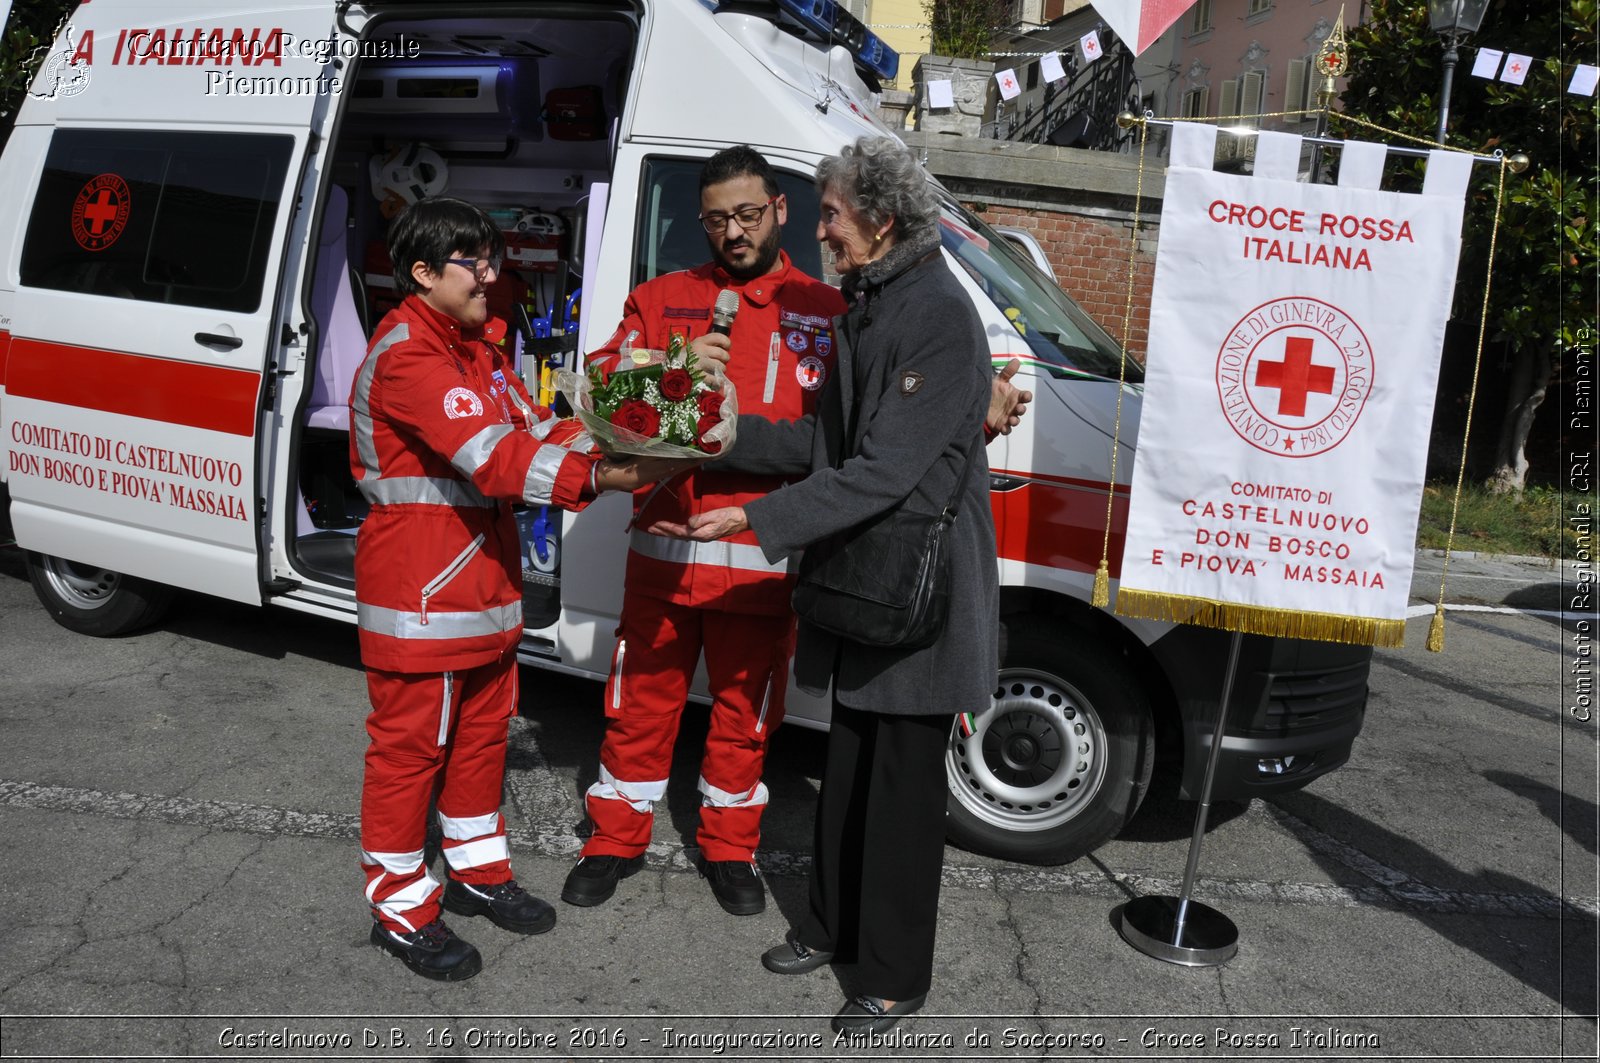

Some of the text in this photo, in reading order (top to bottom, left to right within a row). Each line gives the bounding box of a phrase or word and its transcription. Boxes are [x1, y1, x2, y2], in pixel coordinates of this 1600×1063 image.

[111, 28, 283, 67] ITALIANA
[1207, 199, 1414, 243] CROCE ROSSA
[1243, 235, 1373, 272] ITALIANA
[1221, 301, 1367, 451] CONVENZIONE DI GINEVRA 22 AGOSTO 1864
[11, 420, 243, 488] COMITATO DI CASTELNUOVO
[9, 449, 249, 522] DON BOSCO E PIOVA' MASSAIA
[1231, 481, 1333, 505] COMITATO DI
[1182, 499, 1370, 535] CASTELNUOVO
[1195, 527, 1351, 561] DON BOSCO
[1151, 549, 1164, 566] E
[1283, 563, 1386, 590] MASSAIA
